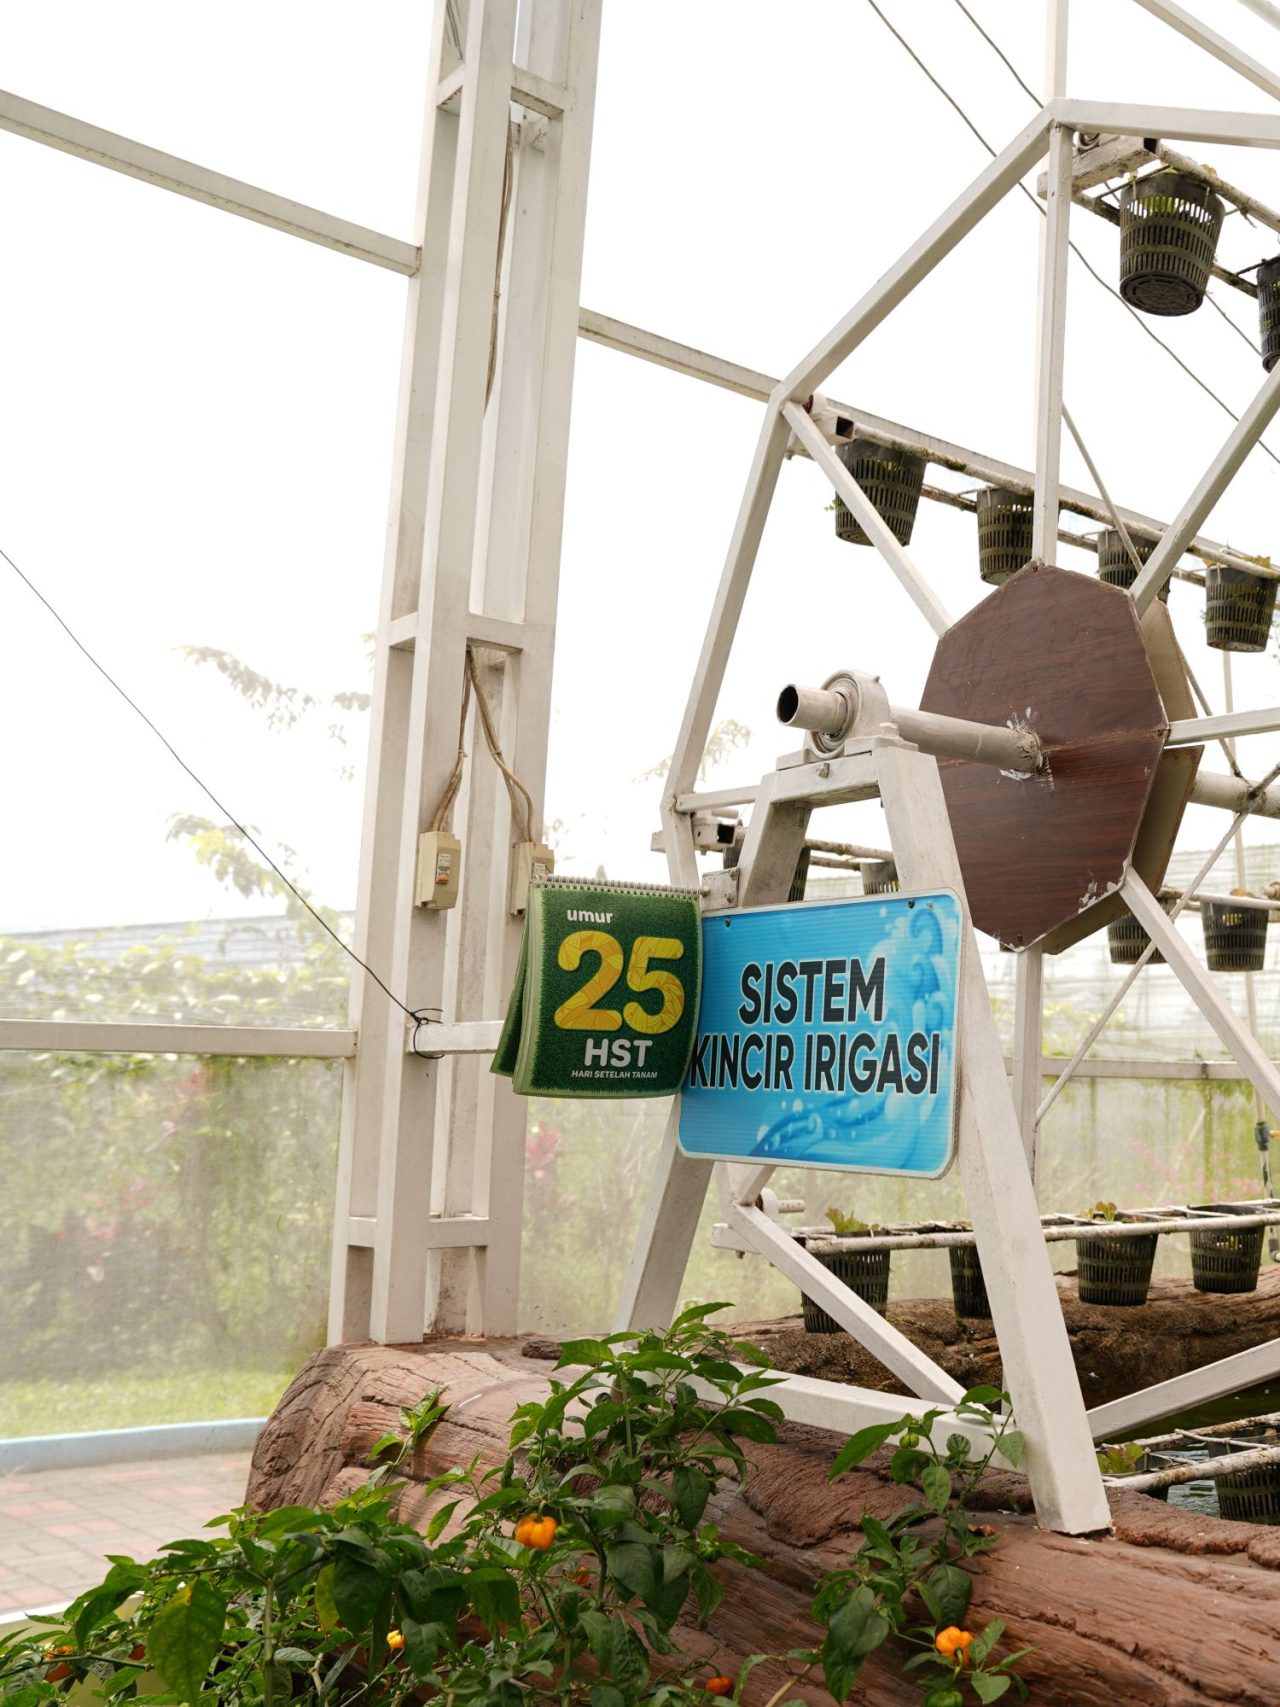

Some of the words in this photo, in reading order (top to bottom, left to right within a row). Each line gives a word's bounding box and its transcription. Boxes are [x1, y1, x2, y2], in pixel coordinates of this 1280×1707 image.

[567, 909, 613, 924] umur
[554, 930, 685, 1034] 25
[738, 957, 886, 1025] SISTEM
[571, 1070, 593, 1078] HARI
[594, 1070, 631, 1079] SETELAH
[632, 1071, 658, 1079] TANAM
[584, 1038, 653, 1067] HST
[690, 1033, 795, 1091] KINCIR
[804, 1032, 941, 1095] IRIGASI
